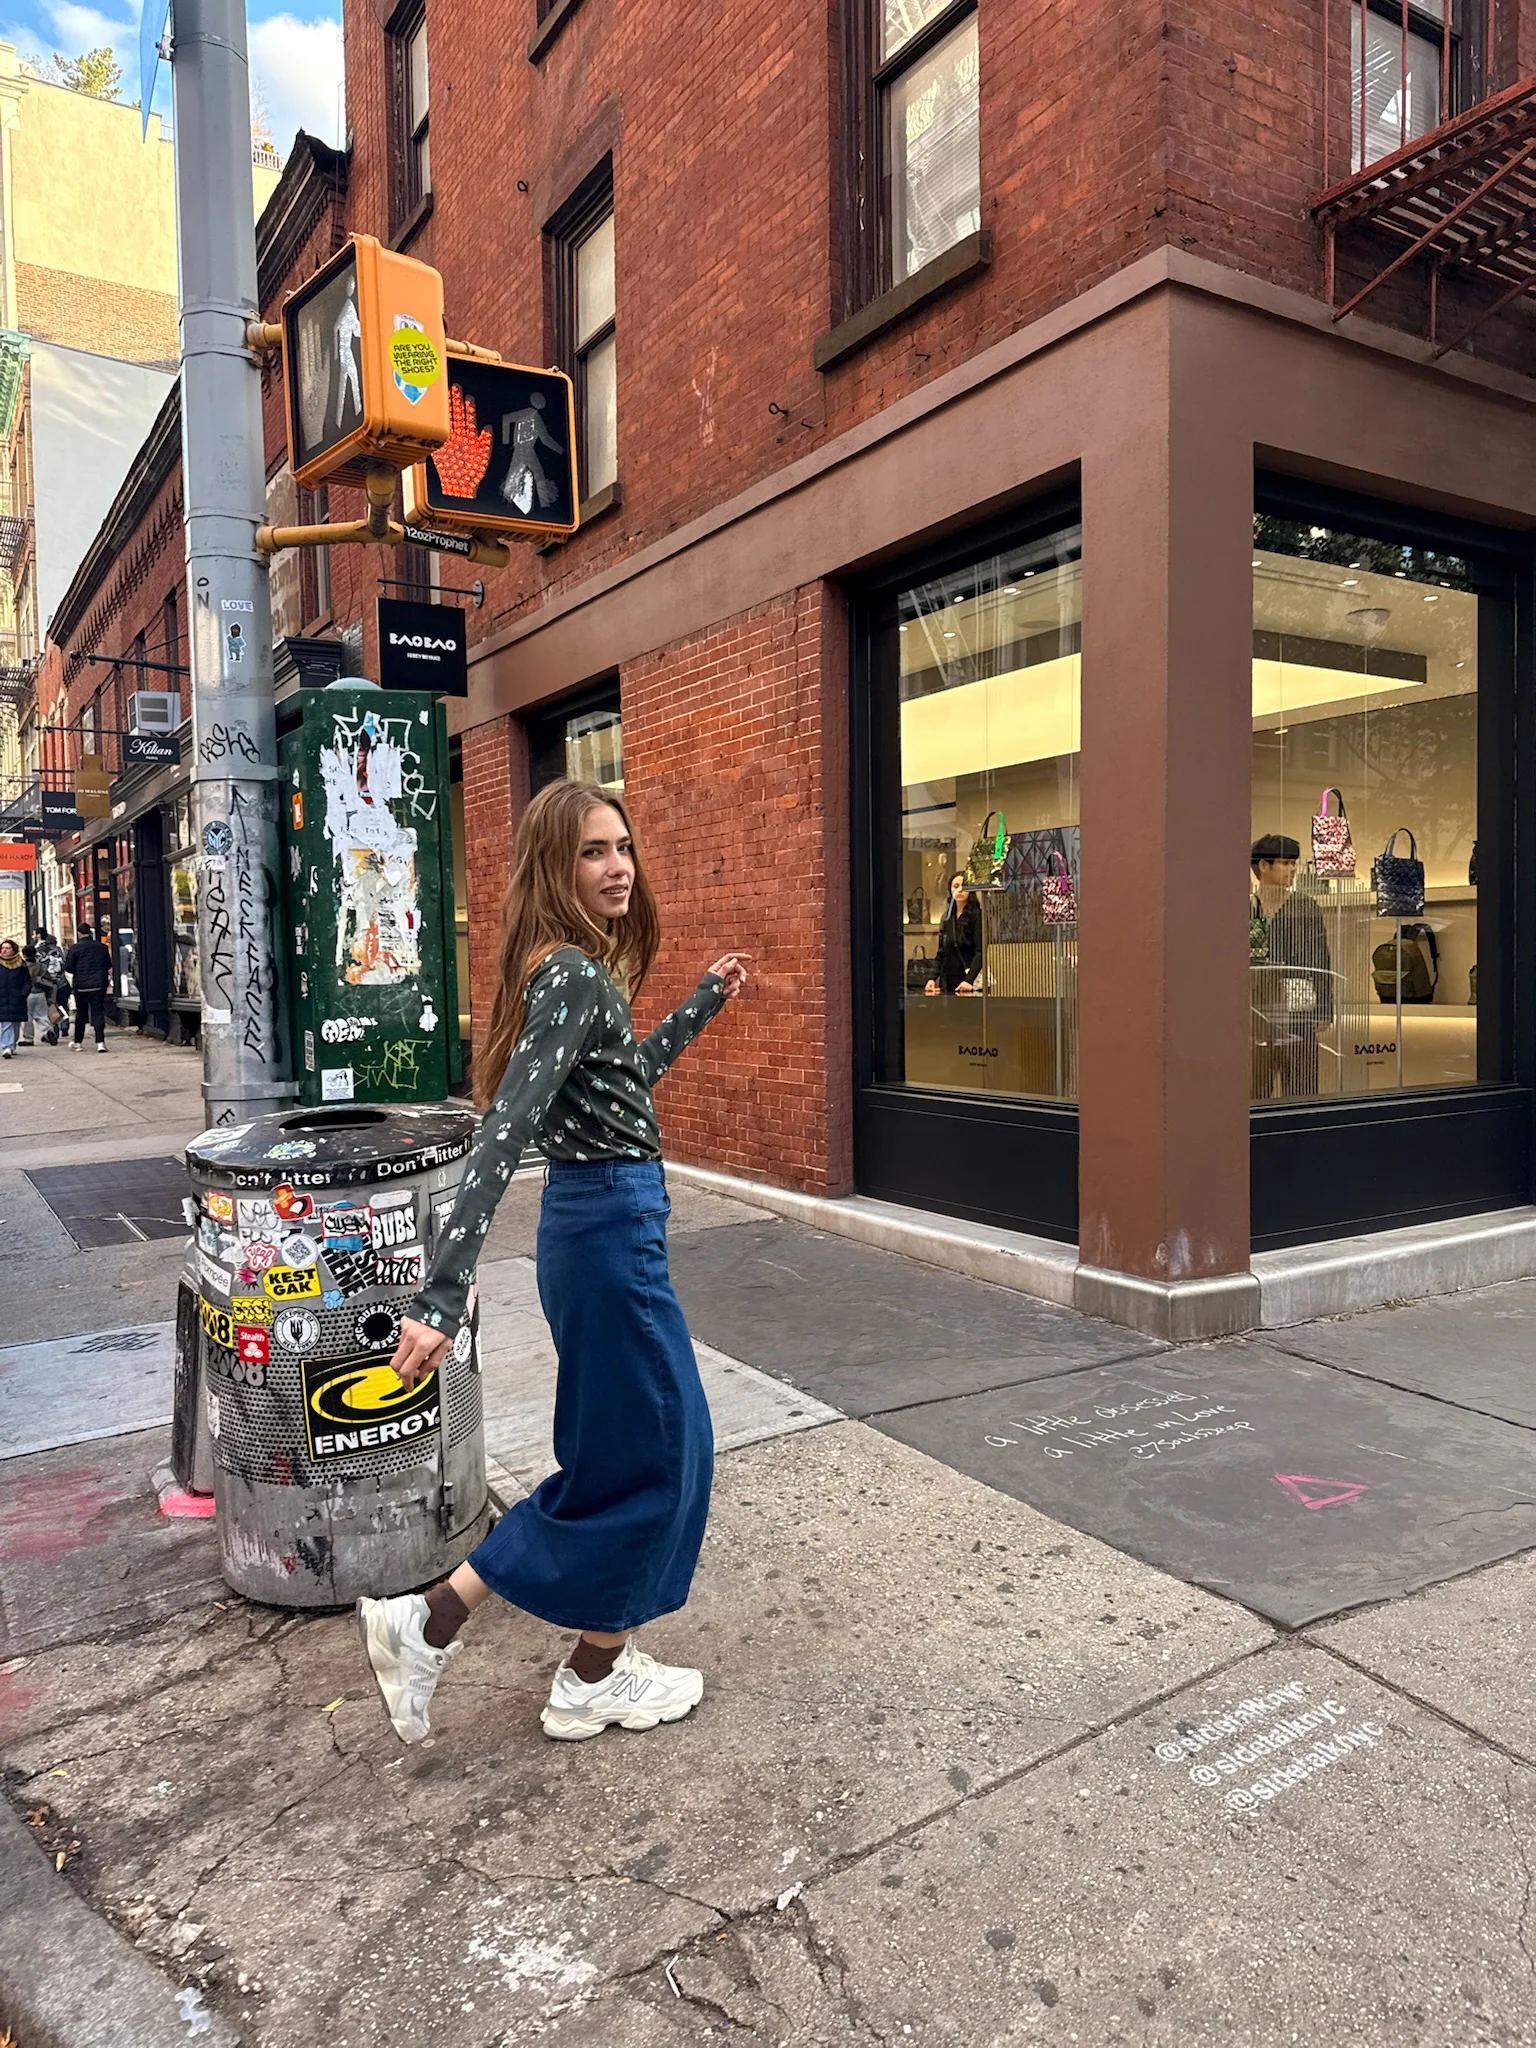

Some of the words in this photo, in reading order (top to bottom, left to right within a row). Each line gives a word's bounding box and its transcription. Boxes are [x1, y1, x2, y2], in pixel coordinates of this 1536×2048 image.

[393, 344, 411, 352] ARE
[412, 343, 430, 351] YOU
[393, 351, 435, 360] WEARING
[393, 359, 411, 367] THE
[412, 357, 438, 366] RIGHT
[401, 366, 435, 374] SHOES?
[222, 601, 253, 610] LOVE
[129, 738, 174, 757] Kilian
[62, 807, 77, 815] FOR
[377, 1154, 428, 1177] Don't
[371, 1206, 417, 1250] BUBS
[269, 1269, 315, 1285] KEST
[273, 1281, 314, 1296] GAK
[240, 1331, 266, 1342] Stealth
[354, 1327, 370, 1346] NYC
[370, 1329, 399, 1350] CREW
[314, 1405, 441, 1455] ENERGY
[1009, 1414, 1092, 1436] little
[1061, 1427, 1149, 1449] little
